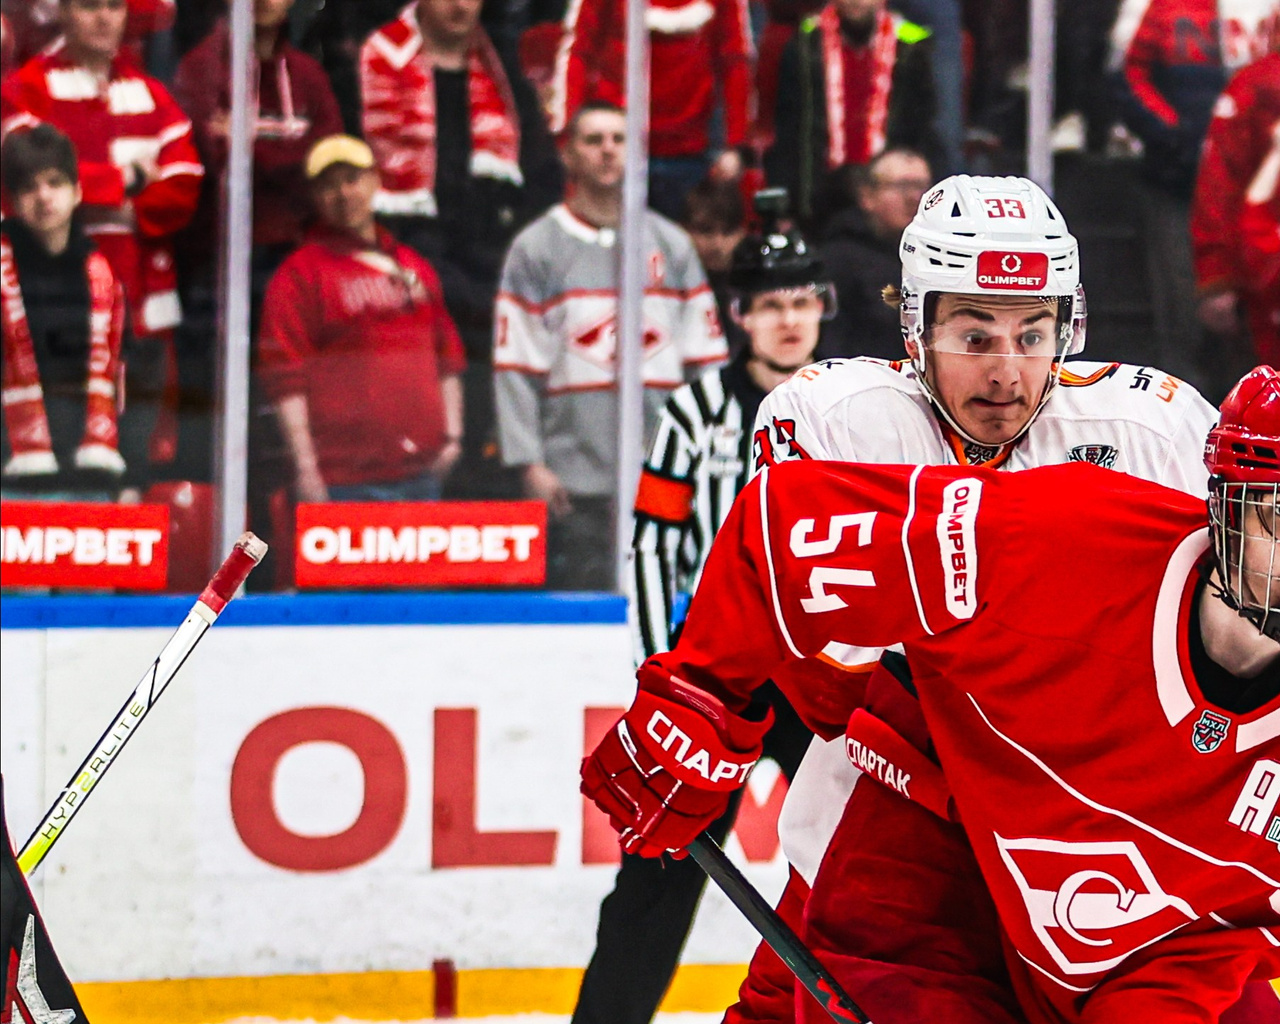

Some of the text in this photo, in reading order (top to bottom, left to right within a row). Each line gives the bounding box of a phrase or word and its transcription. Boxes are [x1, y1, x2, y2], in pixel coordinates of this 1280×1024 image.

[984, 199, 1026, 219] 33
[978, 275, 1042, 286] OLIMPBET
[302, 524, 539, 566] OLIMPBET
[790, 511, 878, 613] 54
[946, 485, 969, 607] OLIMPBET
[1202, 717, 1225, 732] МХЛ
[846, 737, 911, 799] СПАРТАК
